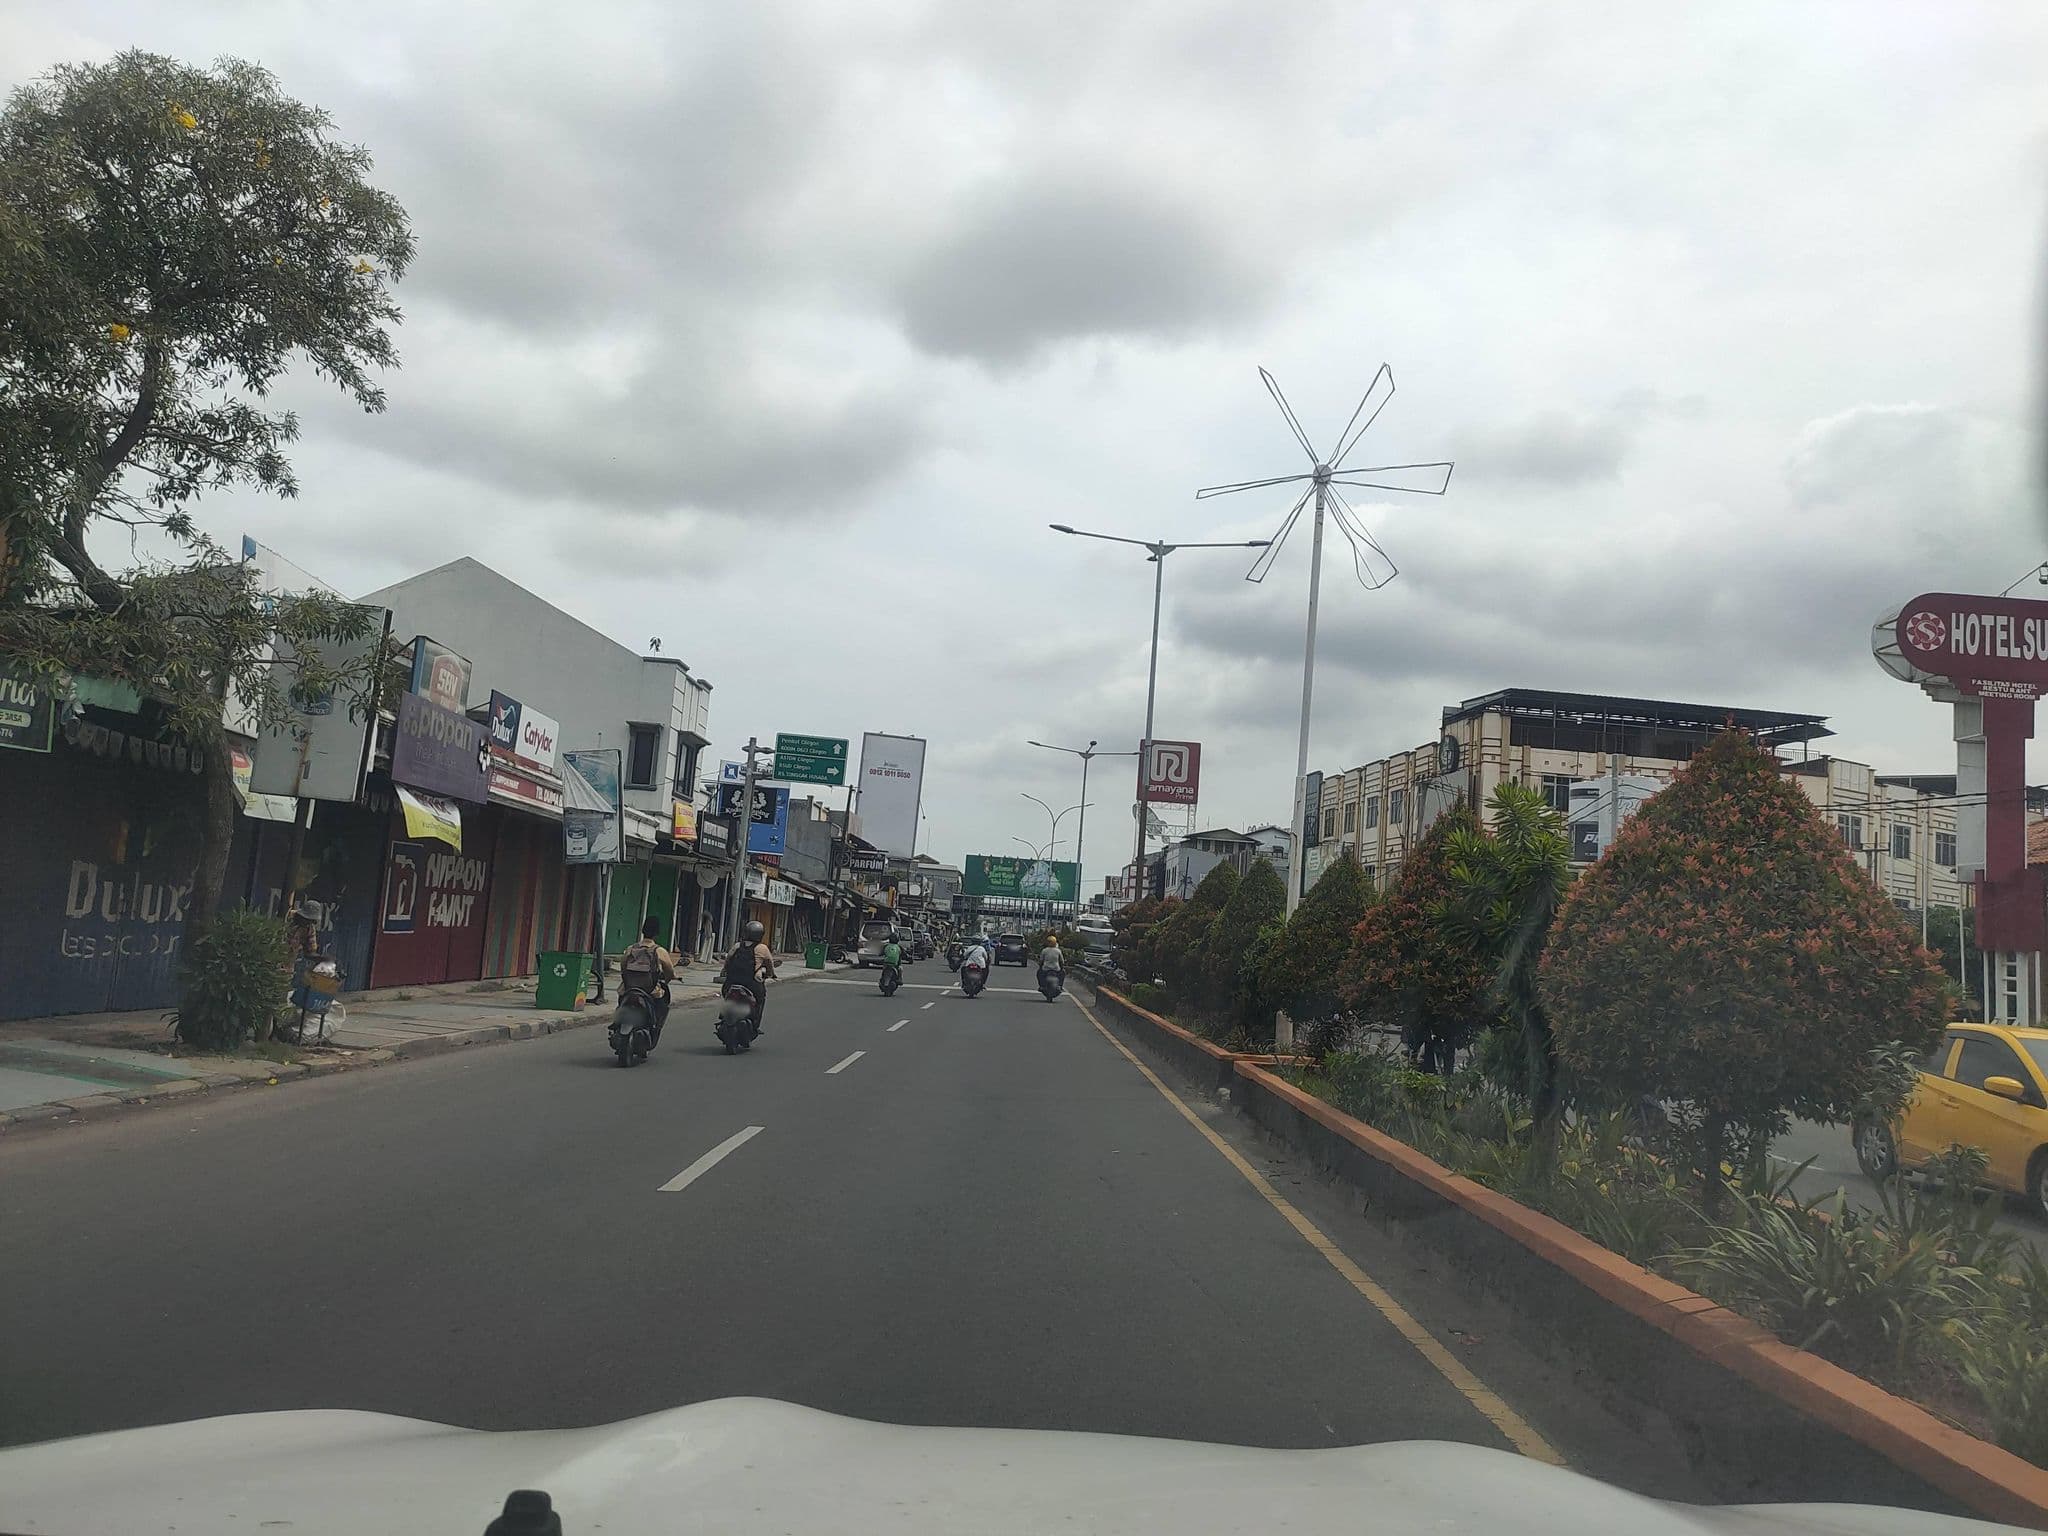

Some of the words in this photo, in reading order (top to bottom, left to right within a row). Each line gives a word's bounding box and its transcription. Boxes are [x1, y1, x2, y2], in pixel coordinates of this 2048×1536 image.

[1971, 679, 2010, 688] FASILITAS
[2011, 682, 2038, 690] HOTEL
[1978, 690, 2013, 699] MEETING
[492, 716, 515, 744] Dulux
[524, 721, 553, 755] Catylac
[1149, 784, 1194, 795] amayana
[424, 852, 487, 892] NIPPON
[65, 860, 189, 923] Dulux
